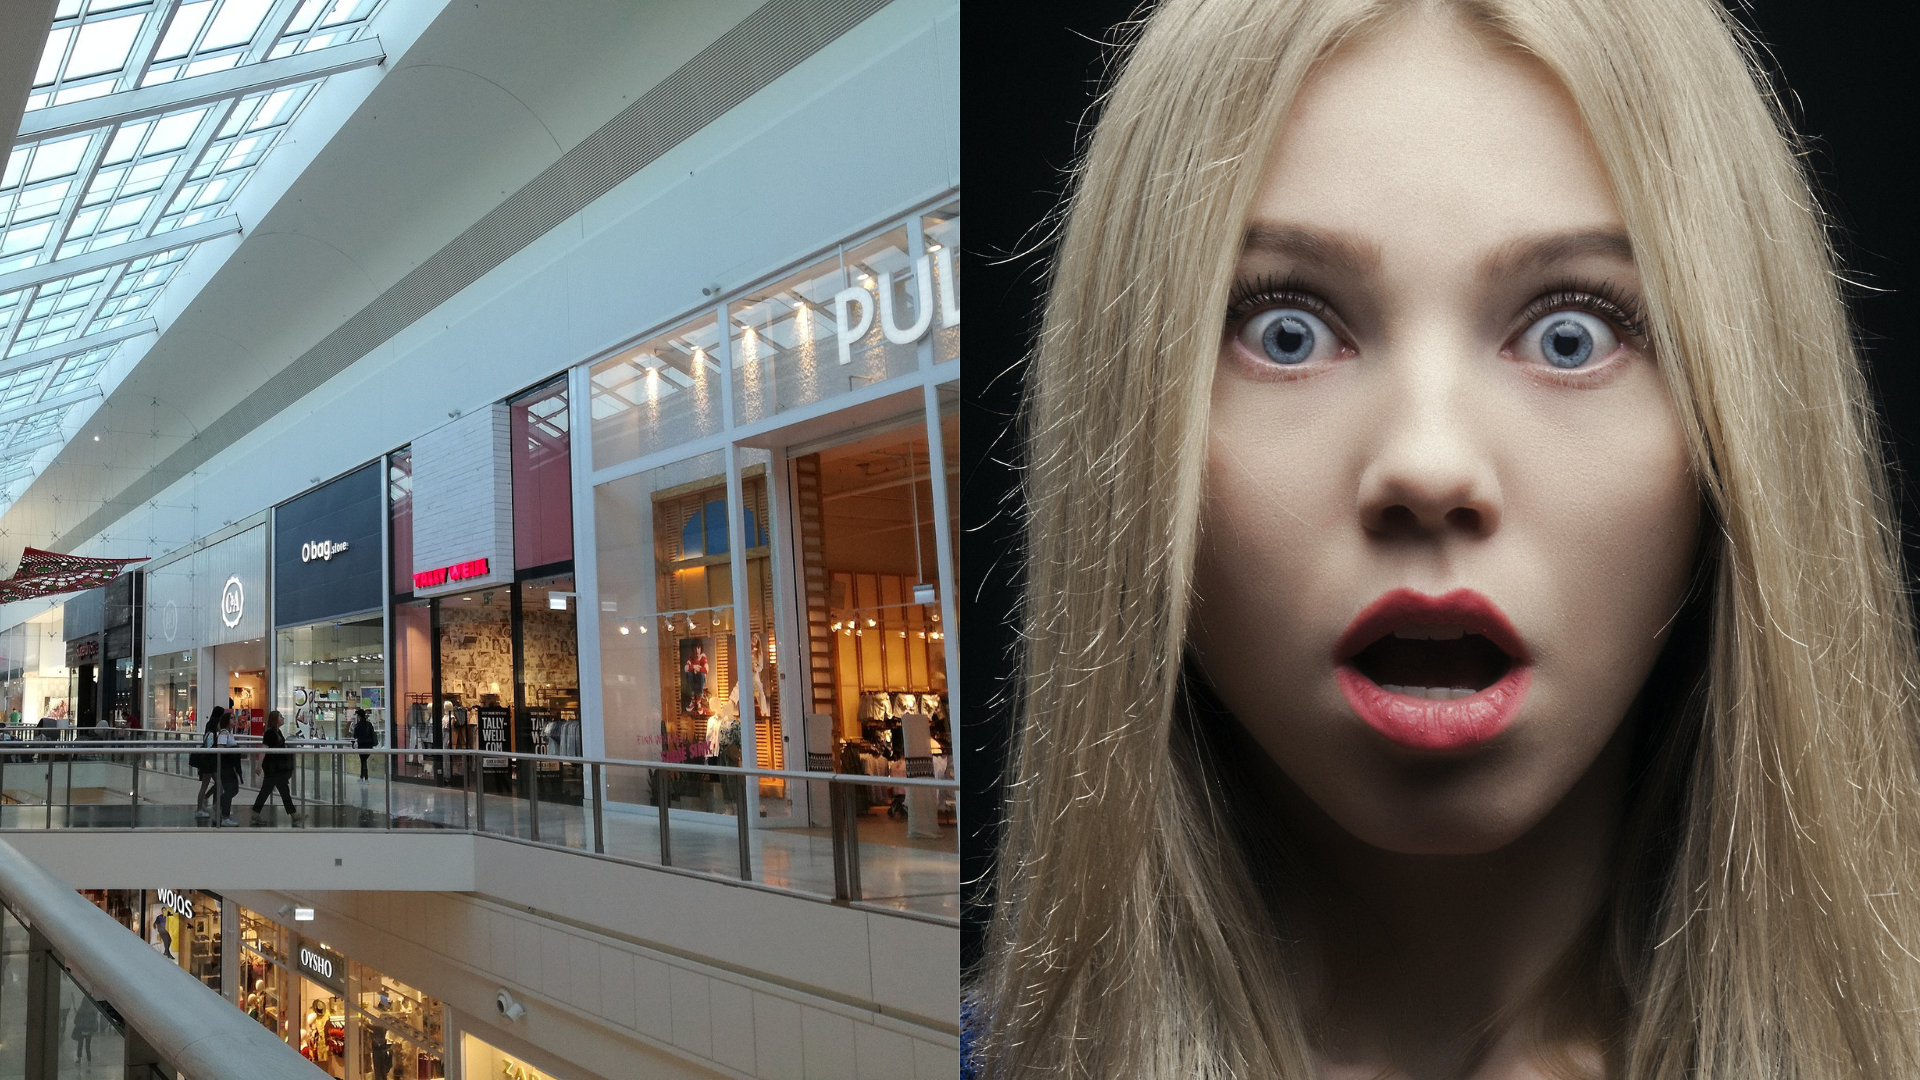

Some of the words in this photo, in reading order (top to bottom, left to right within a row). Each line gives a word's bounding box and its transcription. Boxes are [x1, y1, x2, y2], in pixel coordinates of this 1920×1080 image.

[412, 567, 447, 588] TALLY
[482, 730, 506, 742] WEIJL
[300, 948, 333, 978] OYSHO
